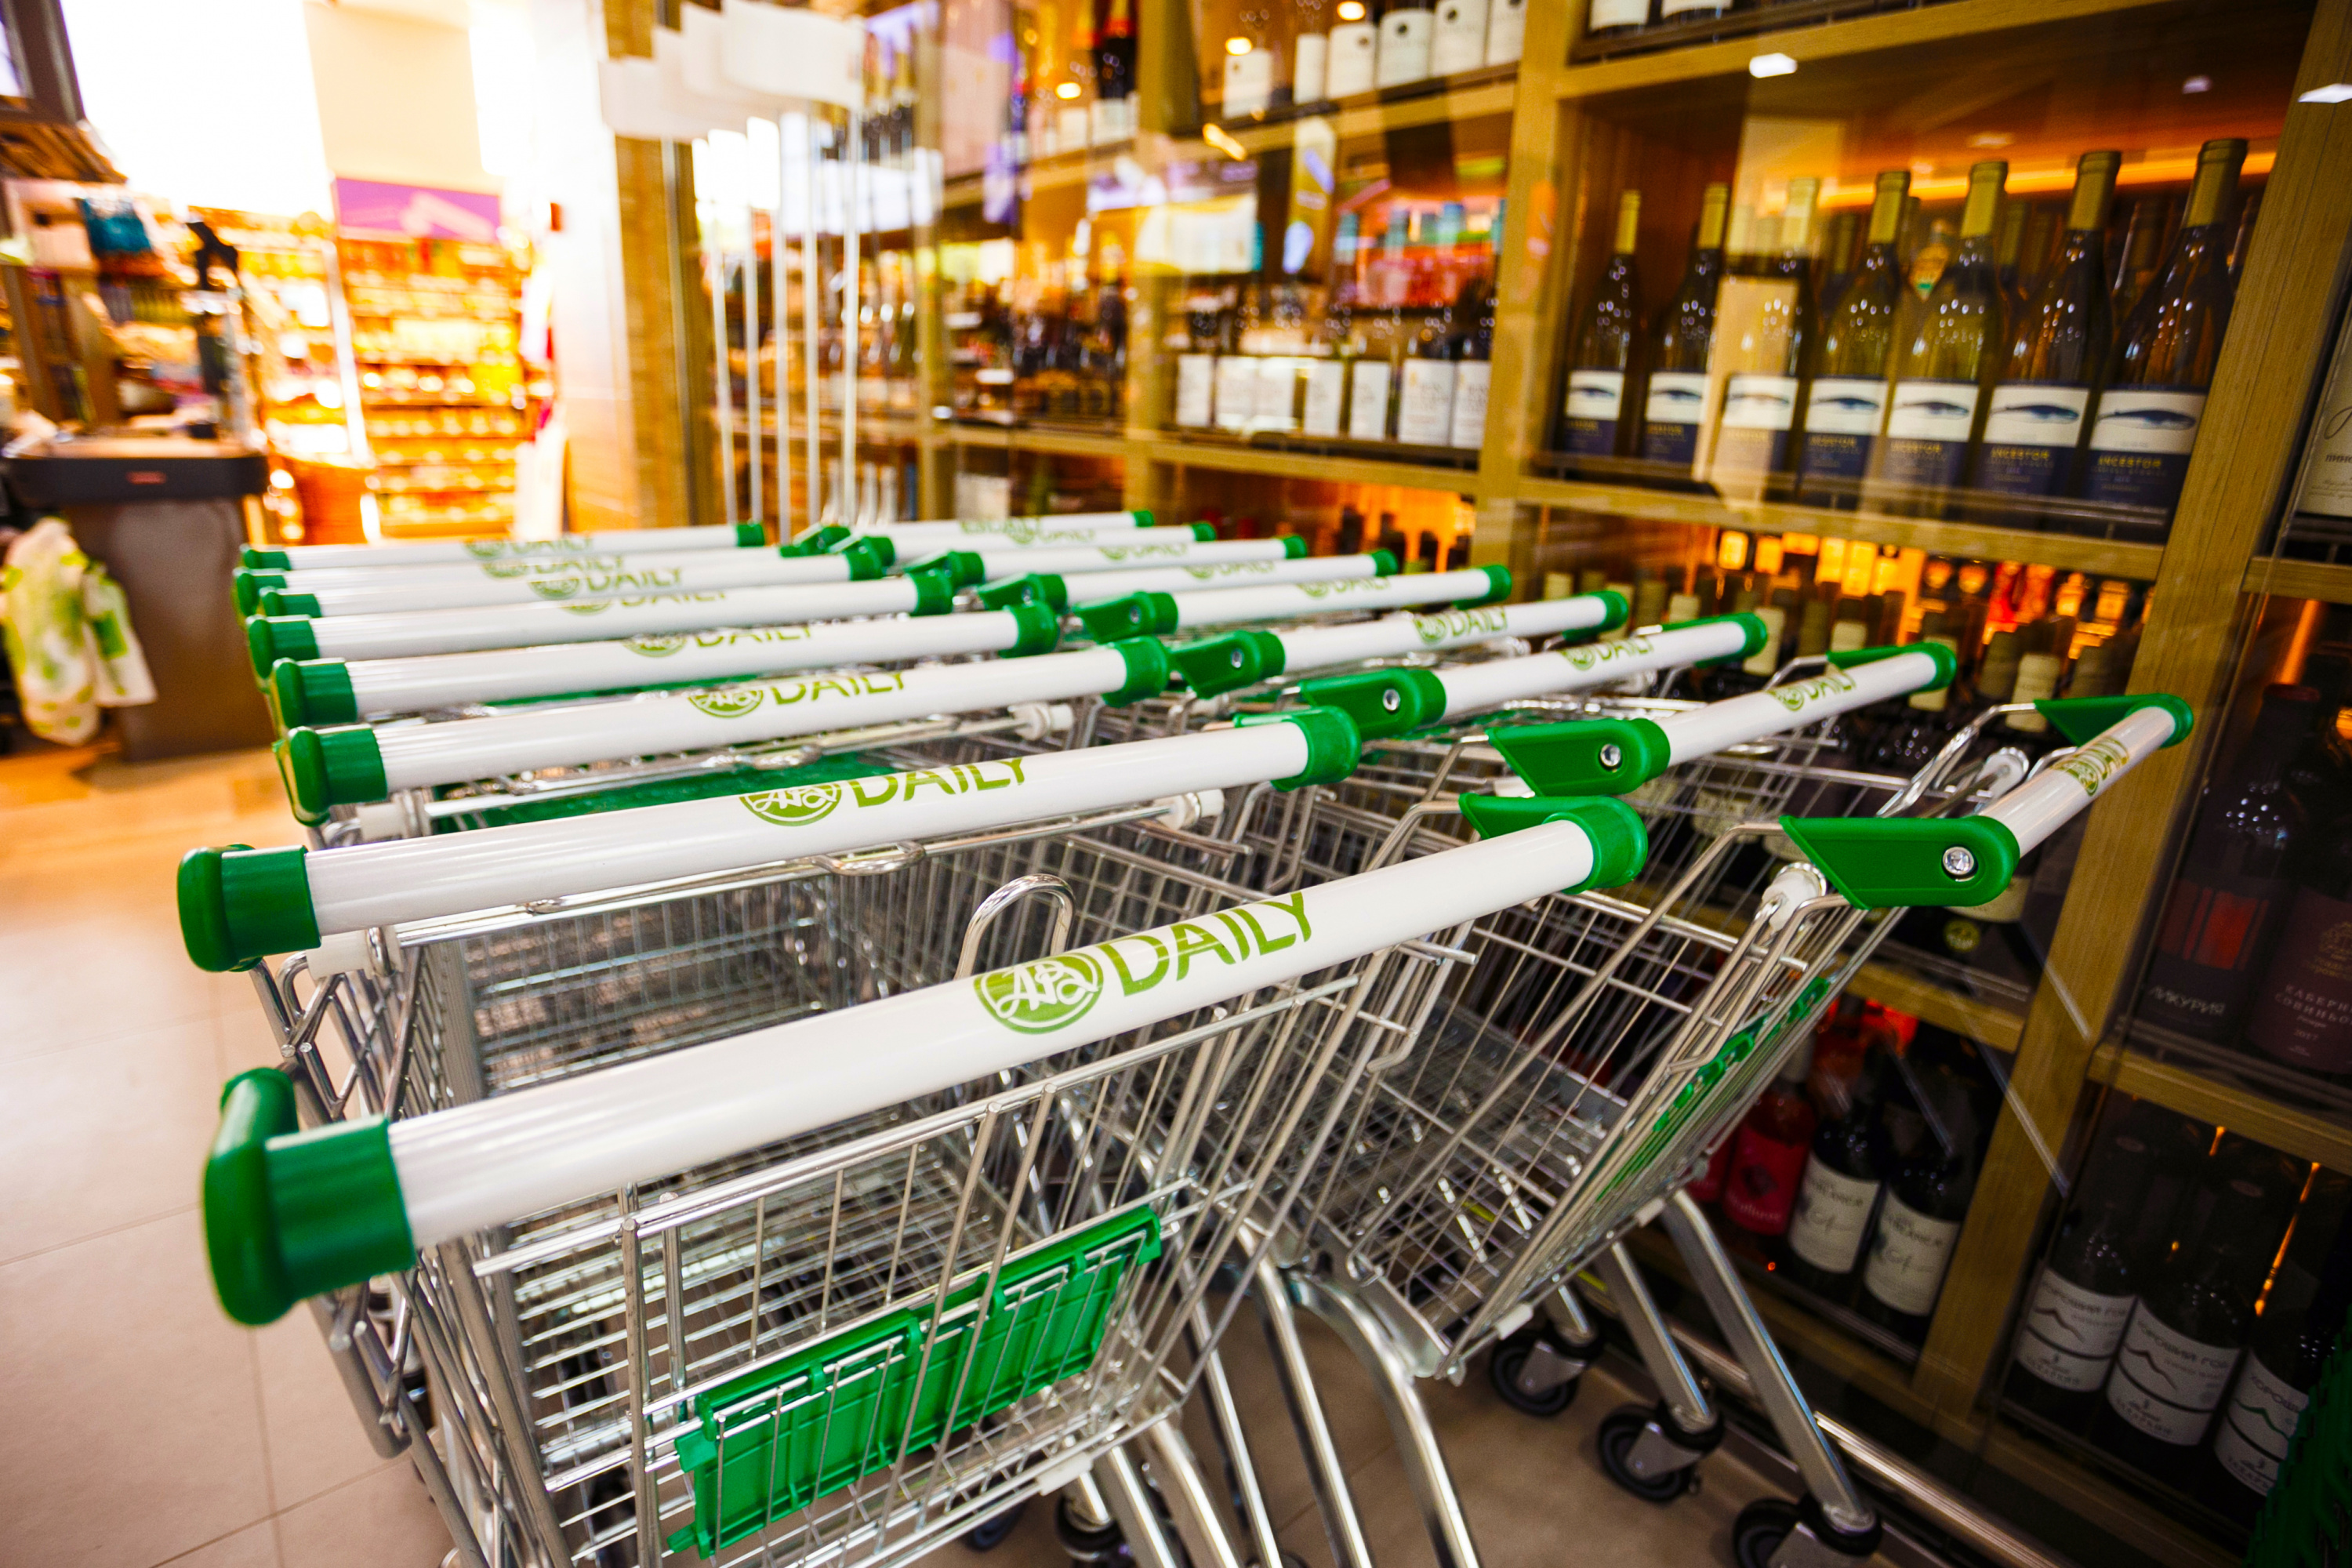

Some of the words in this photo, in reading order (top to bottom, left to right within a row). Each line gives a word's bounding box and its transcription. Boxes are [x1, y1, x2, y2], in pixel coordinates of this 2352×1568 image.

[848, 757, 1025, 808] DAILY
[1097, 891, 1312, 997] DAILY
[2274, 993, 2352, 1026] СОВИНЬО
[2285, 983, 2352, 1014] КАБЕРН
